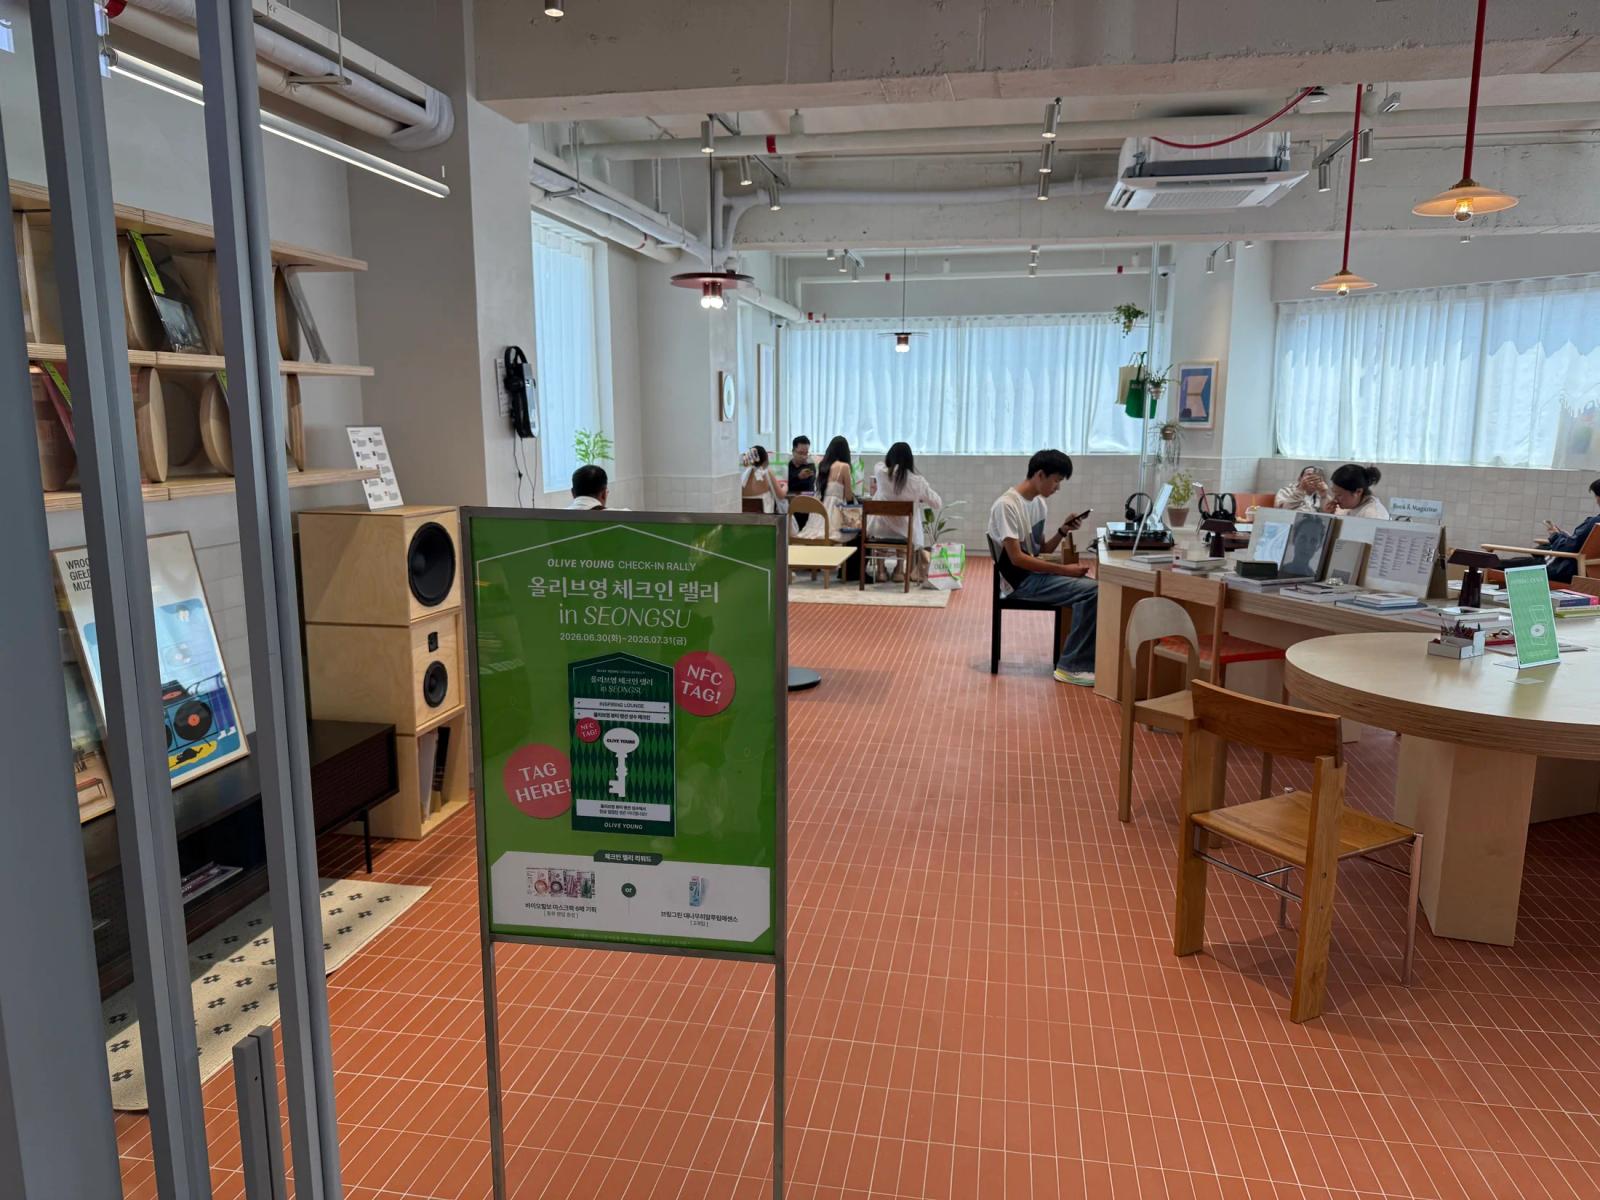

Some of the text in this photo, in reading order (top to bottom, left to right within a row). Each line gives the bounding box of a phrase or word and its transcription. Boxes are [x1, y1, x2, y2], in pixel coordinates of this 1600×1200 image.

[547, 558, 696, 571] OLIVE YOUNG CHECK-IN RALLY
[528, 577, 719, 603] 올리브영 체크인 랠리
[559, 603, 692, 629] in SEONGSU
[687, 664, 723, 686] NFC
[681, 681, 721, 704] TAG!
[518, 762, 558, 782] TAG
[515, 778, 571, 802] HERE!
